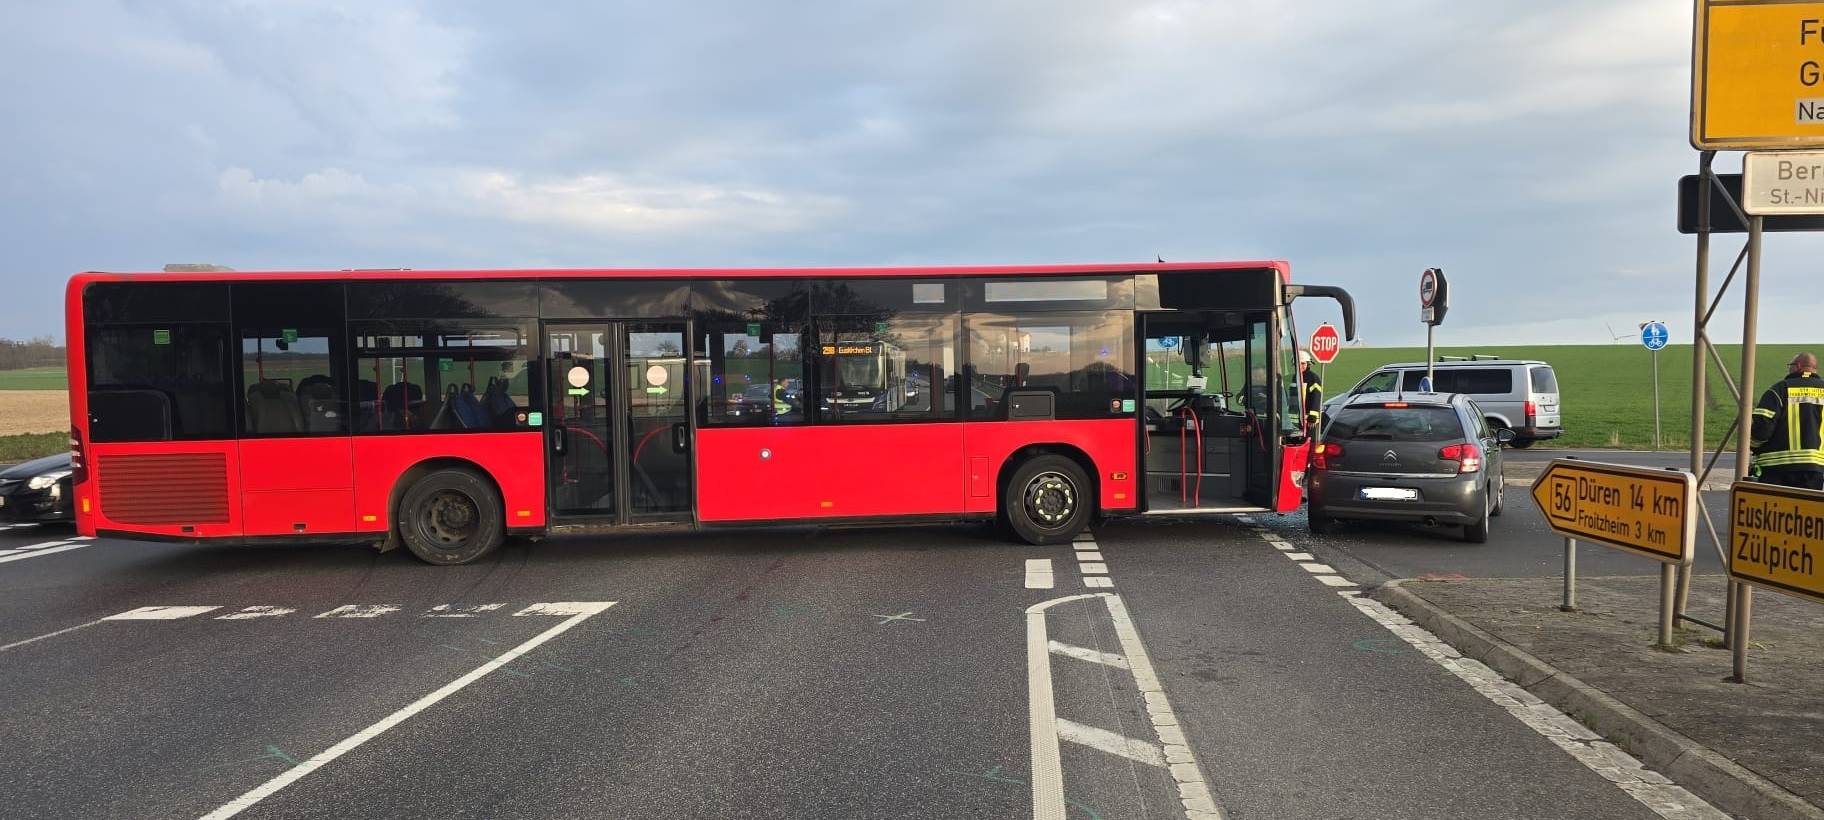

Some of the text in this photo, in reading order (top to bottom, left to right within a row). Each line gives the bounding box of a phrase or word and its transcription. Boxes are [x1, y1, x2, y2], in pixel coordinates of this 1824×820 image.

[1801, 18, 1824, 46] F
[1800, 61, 1824, 86] G
[1778, 160, 1824, 180] Ber
[1313, 336, 1337, 352] STOP
[1554, 483, 1571, 512] 56
[1578, 477, 1679, 518] Düren 14 km
[1578, 509, 1666, 546] Froitzheim 3 km
[1737, 497, 1824, 541] Euskirchen
[1737, 531, 1813, 575] Zülpich
